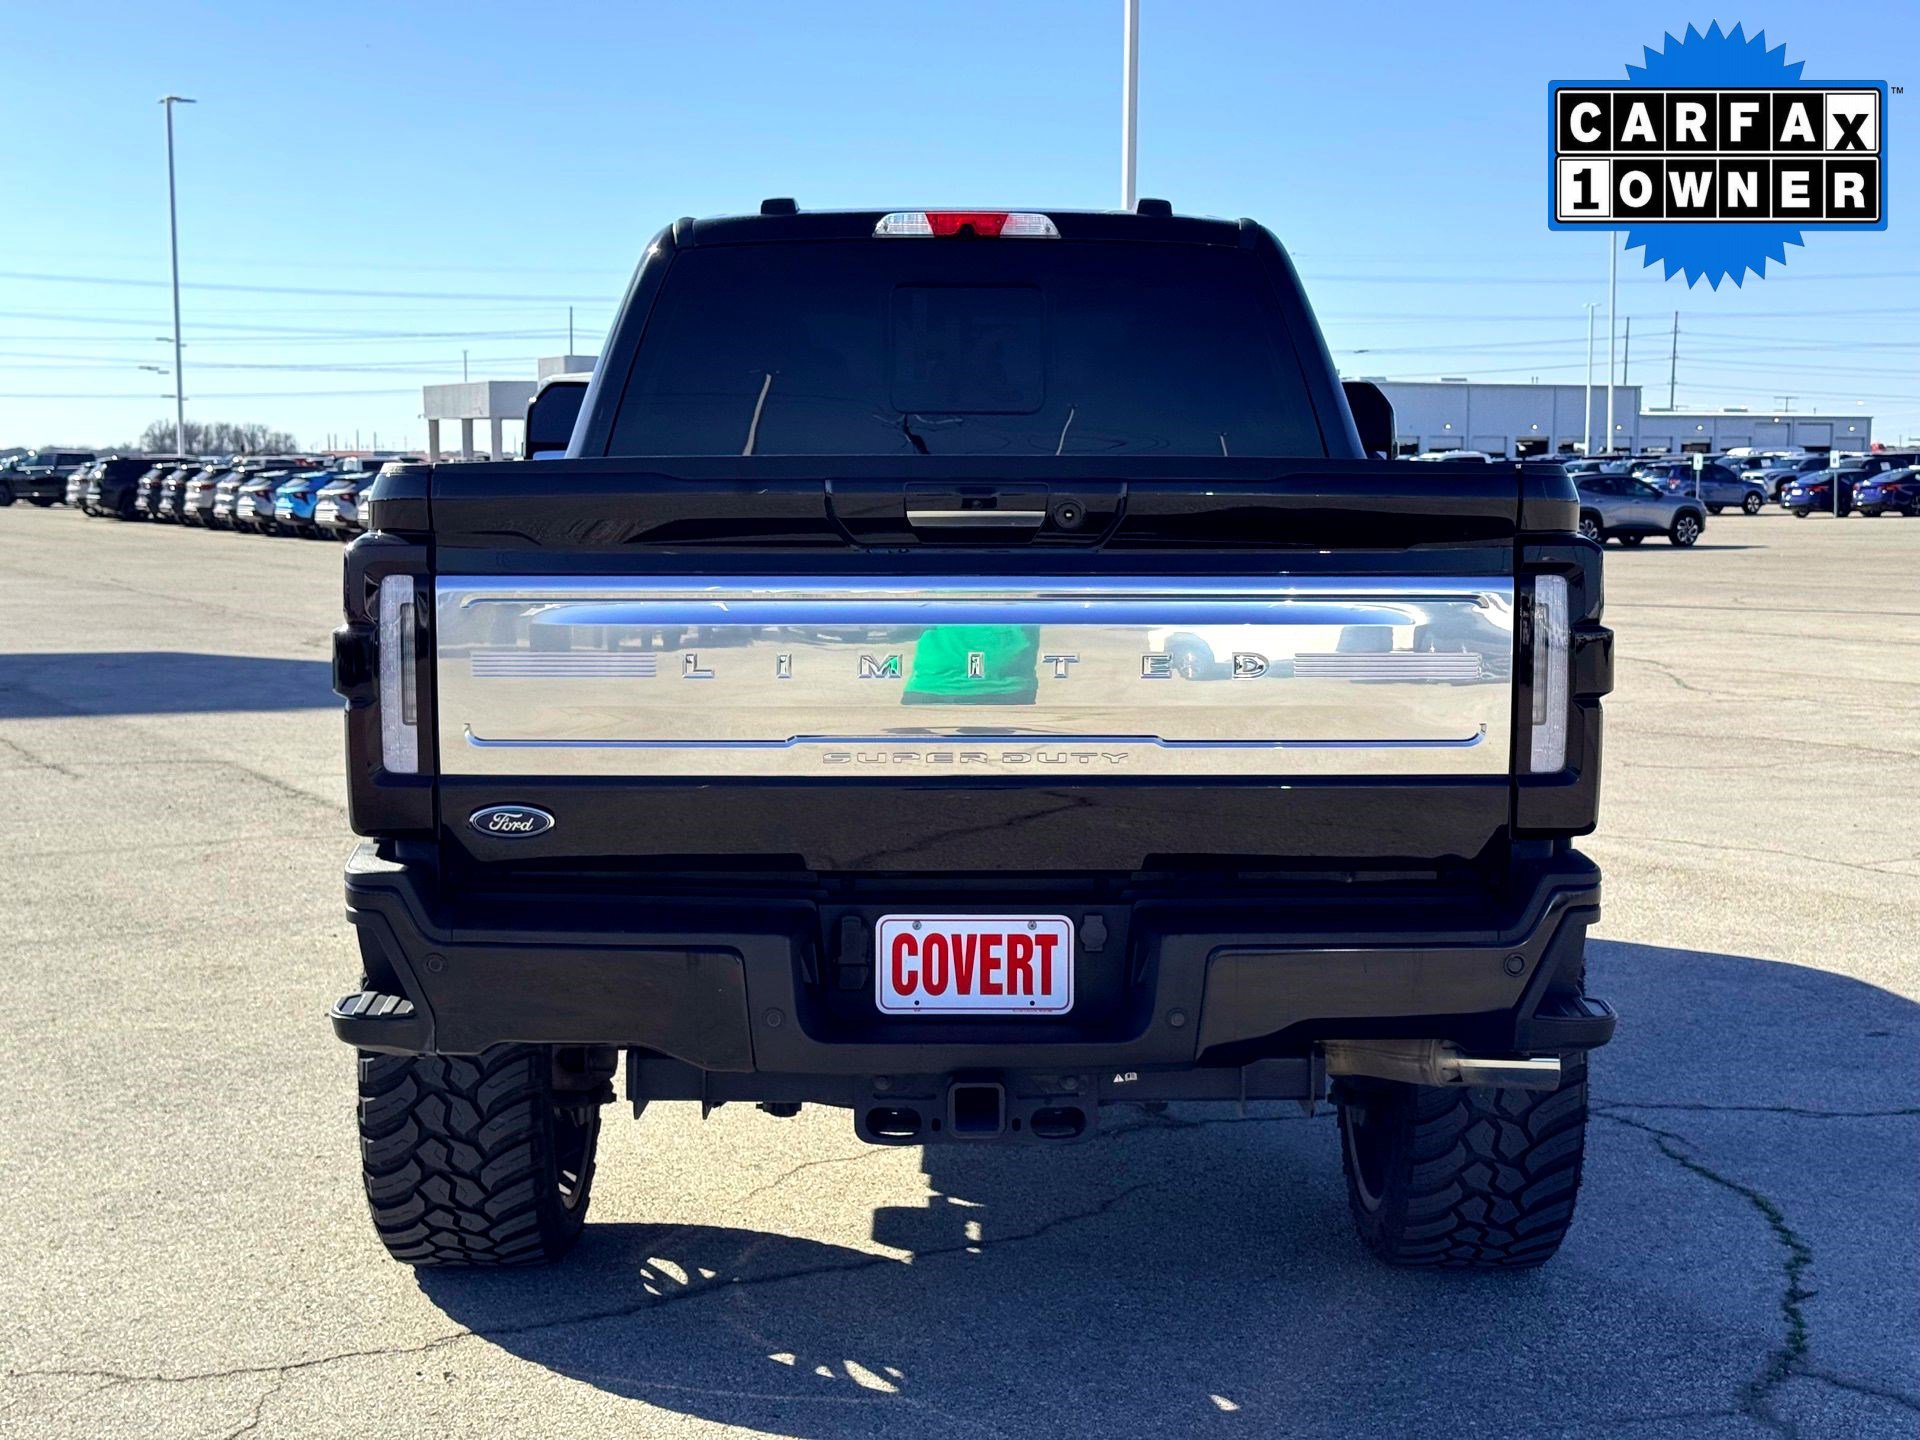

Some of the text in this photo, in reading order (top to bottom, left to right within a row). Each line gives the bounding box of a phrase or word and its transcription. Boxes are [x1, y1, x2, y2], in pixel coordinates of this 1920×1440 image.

[682, 652, 1270, 680] LIMITED
[823, 752, 1129, 764] SUPER DUTY
[489, 812, 534, 831] Ford
[891, 932, 1059, 997] COVERT
